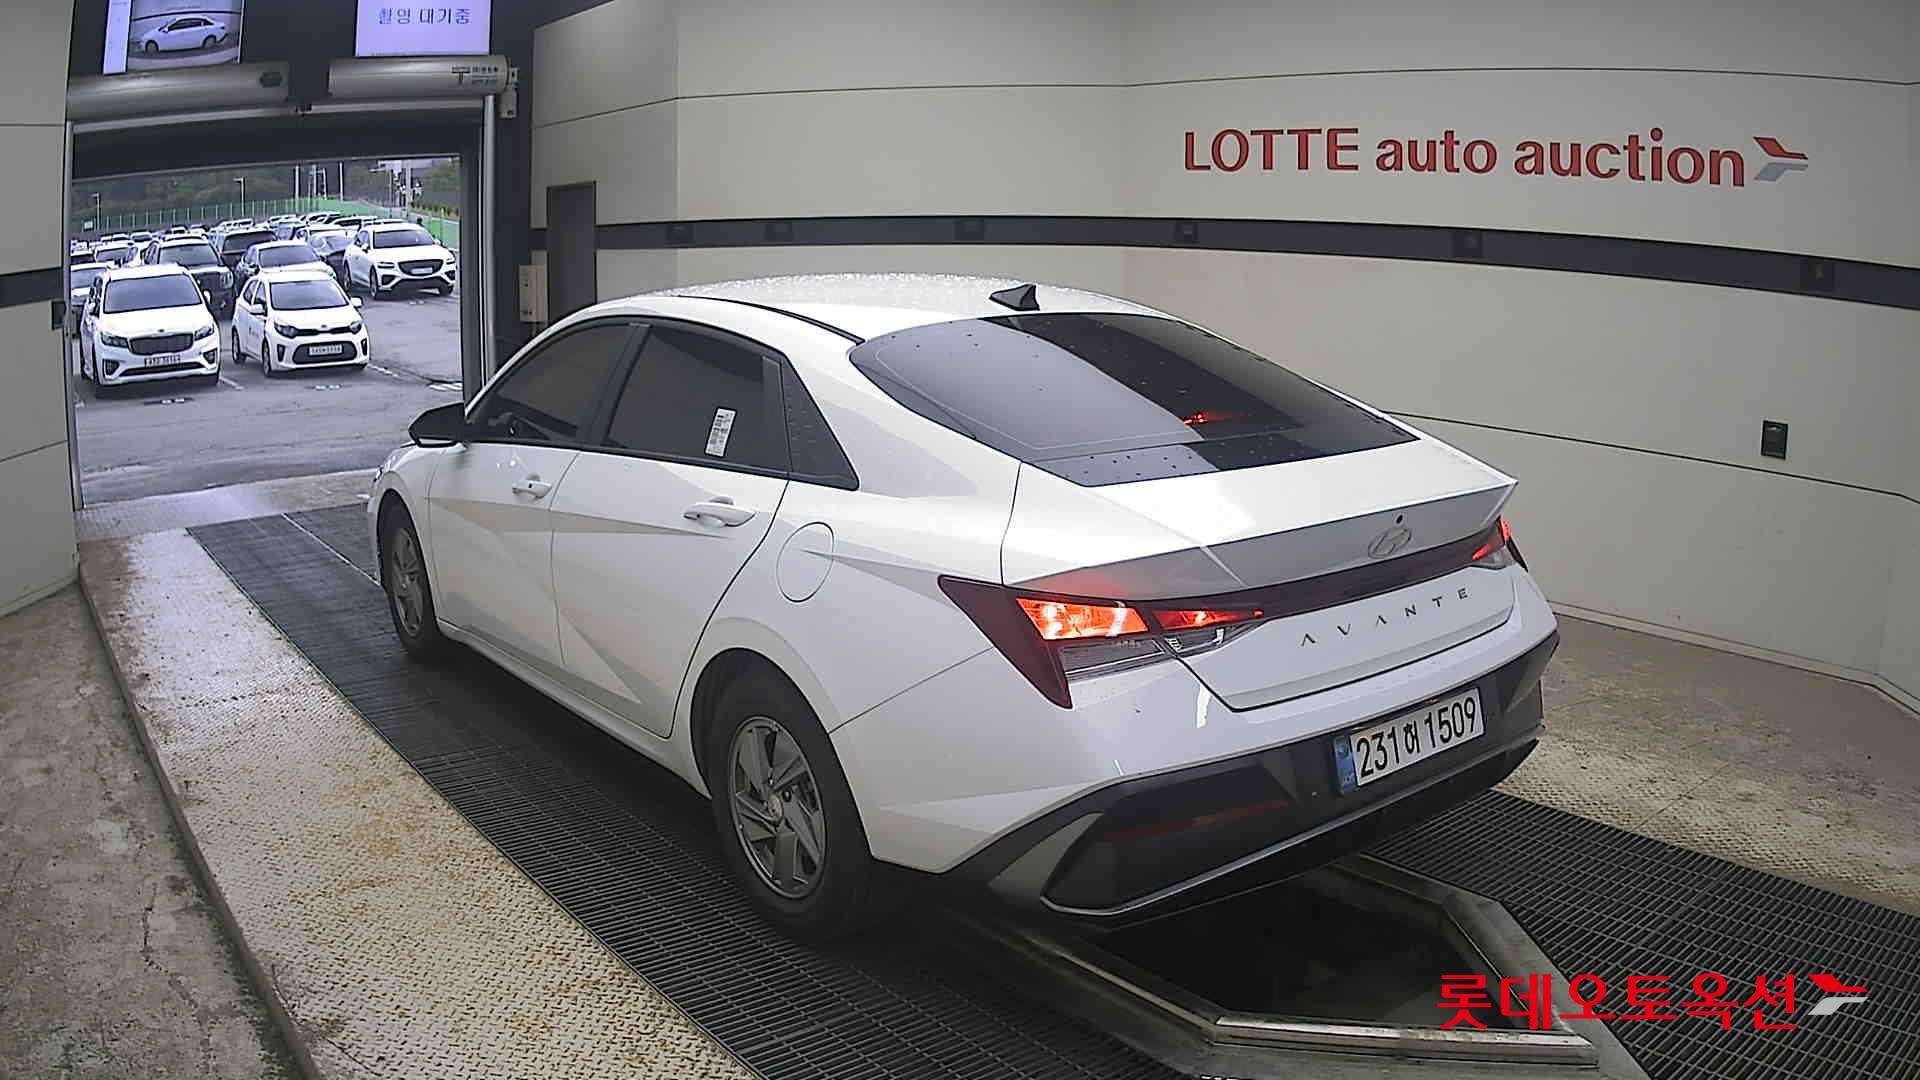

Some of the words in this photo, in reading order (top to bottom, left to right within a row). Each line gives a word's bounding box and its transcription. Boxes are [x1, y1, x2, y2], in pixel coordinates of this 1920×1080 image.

[1185, 128, 1359, 172] LOTTE
[1375, 130, 1498, 173] auto
[1514, 127, 1745, 187] auction
[1300, 587, 1468, 647] AVANTE
